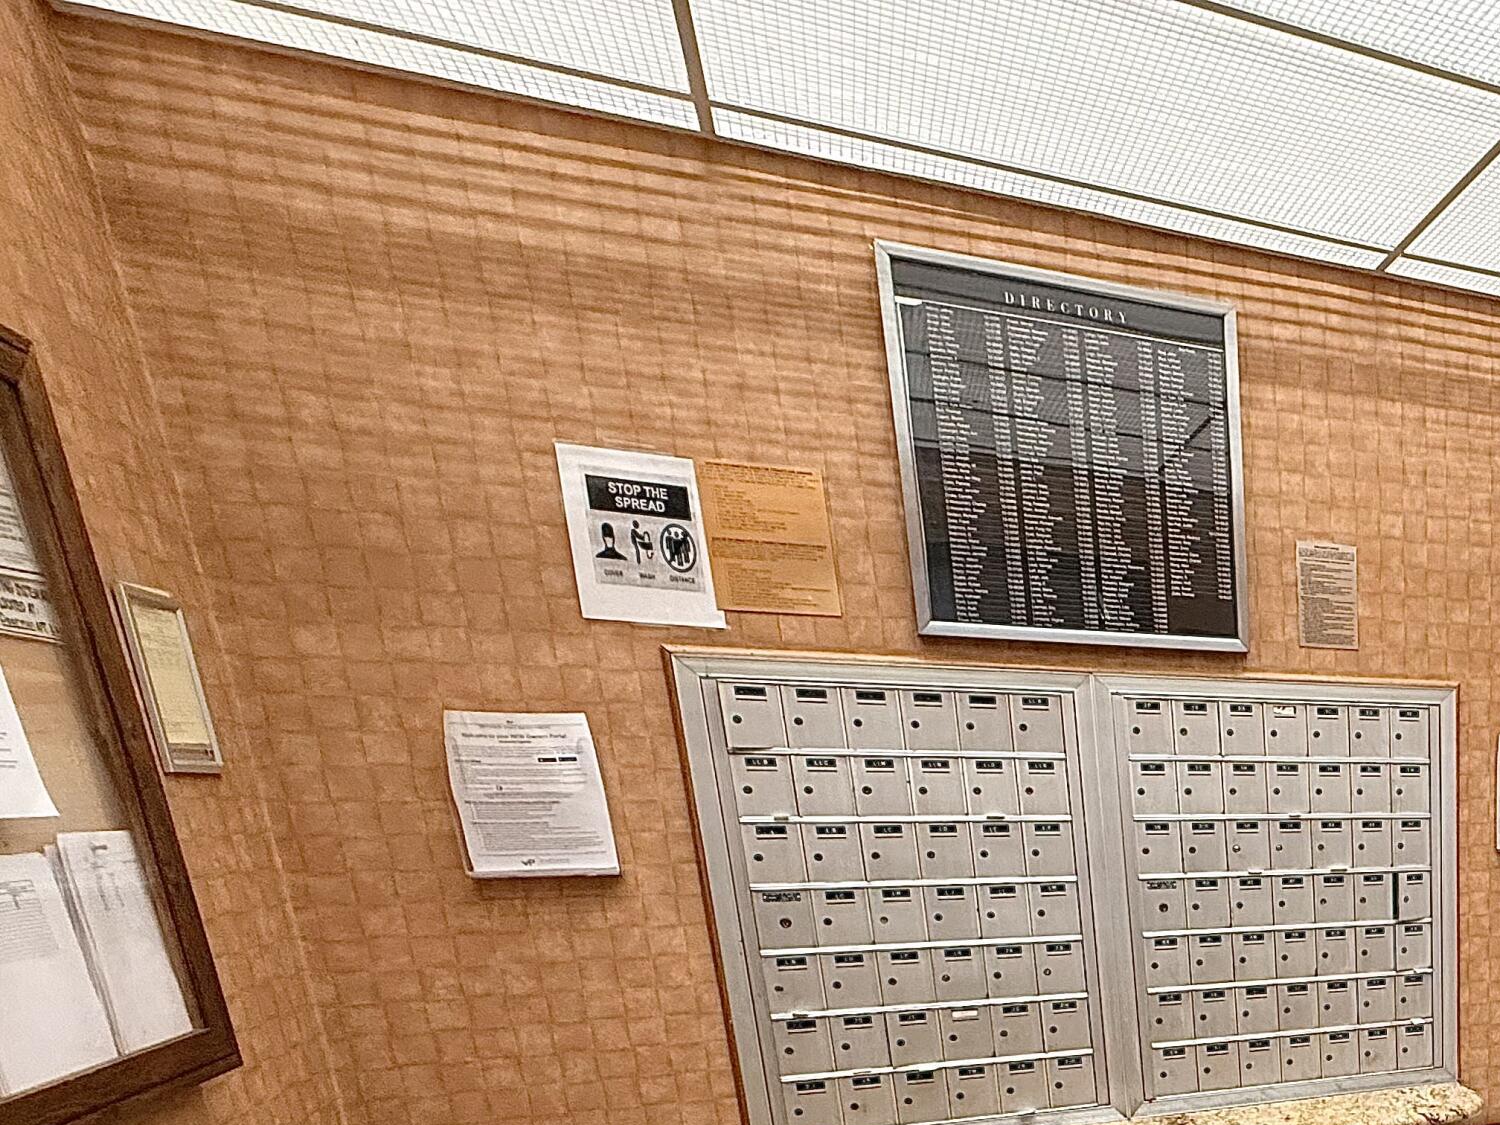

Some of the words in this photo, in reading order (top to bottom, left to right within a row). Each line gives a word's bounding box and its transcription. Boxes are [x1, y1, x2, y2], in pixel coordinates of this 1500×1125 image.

[1004, 291, 1127, 324] DIRECTORY
[608, 481, 643, 496] STOP
[644, 486, 668, 500] THE
[615, 496, 665, 513] SPREAD
[604, 569, 623, 577] COVER
[669, 575, 696, 584] DISTANCE
